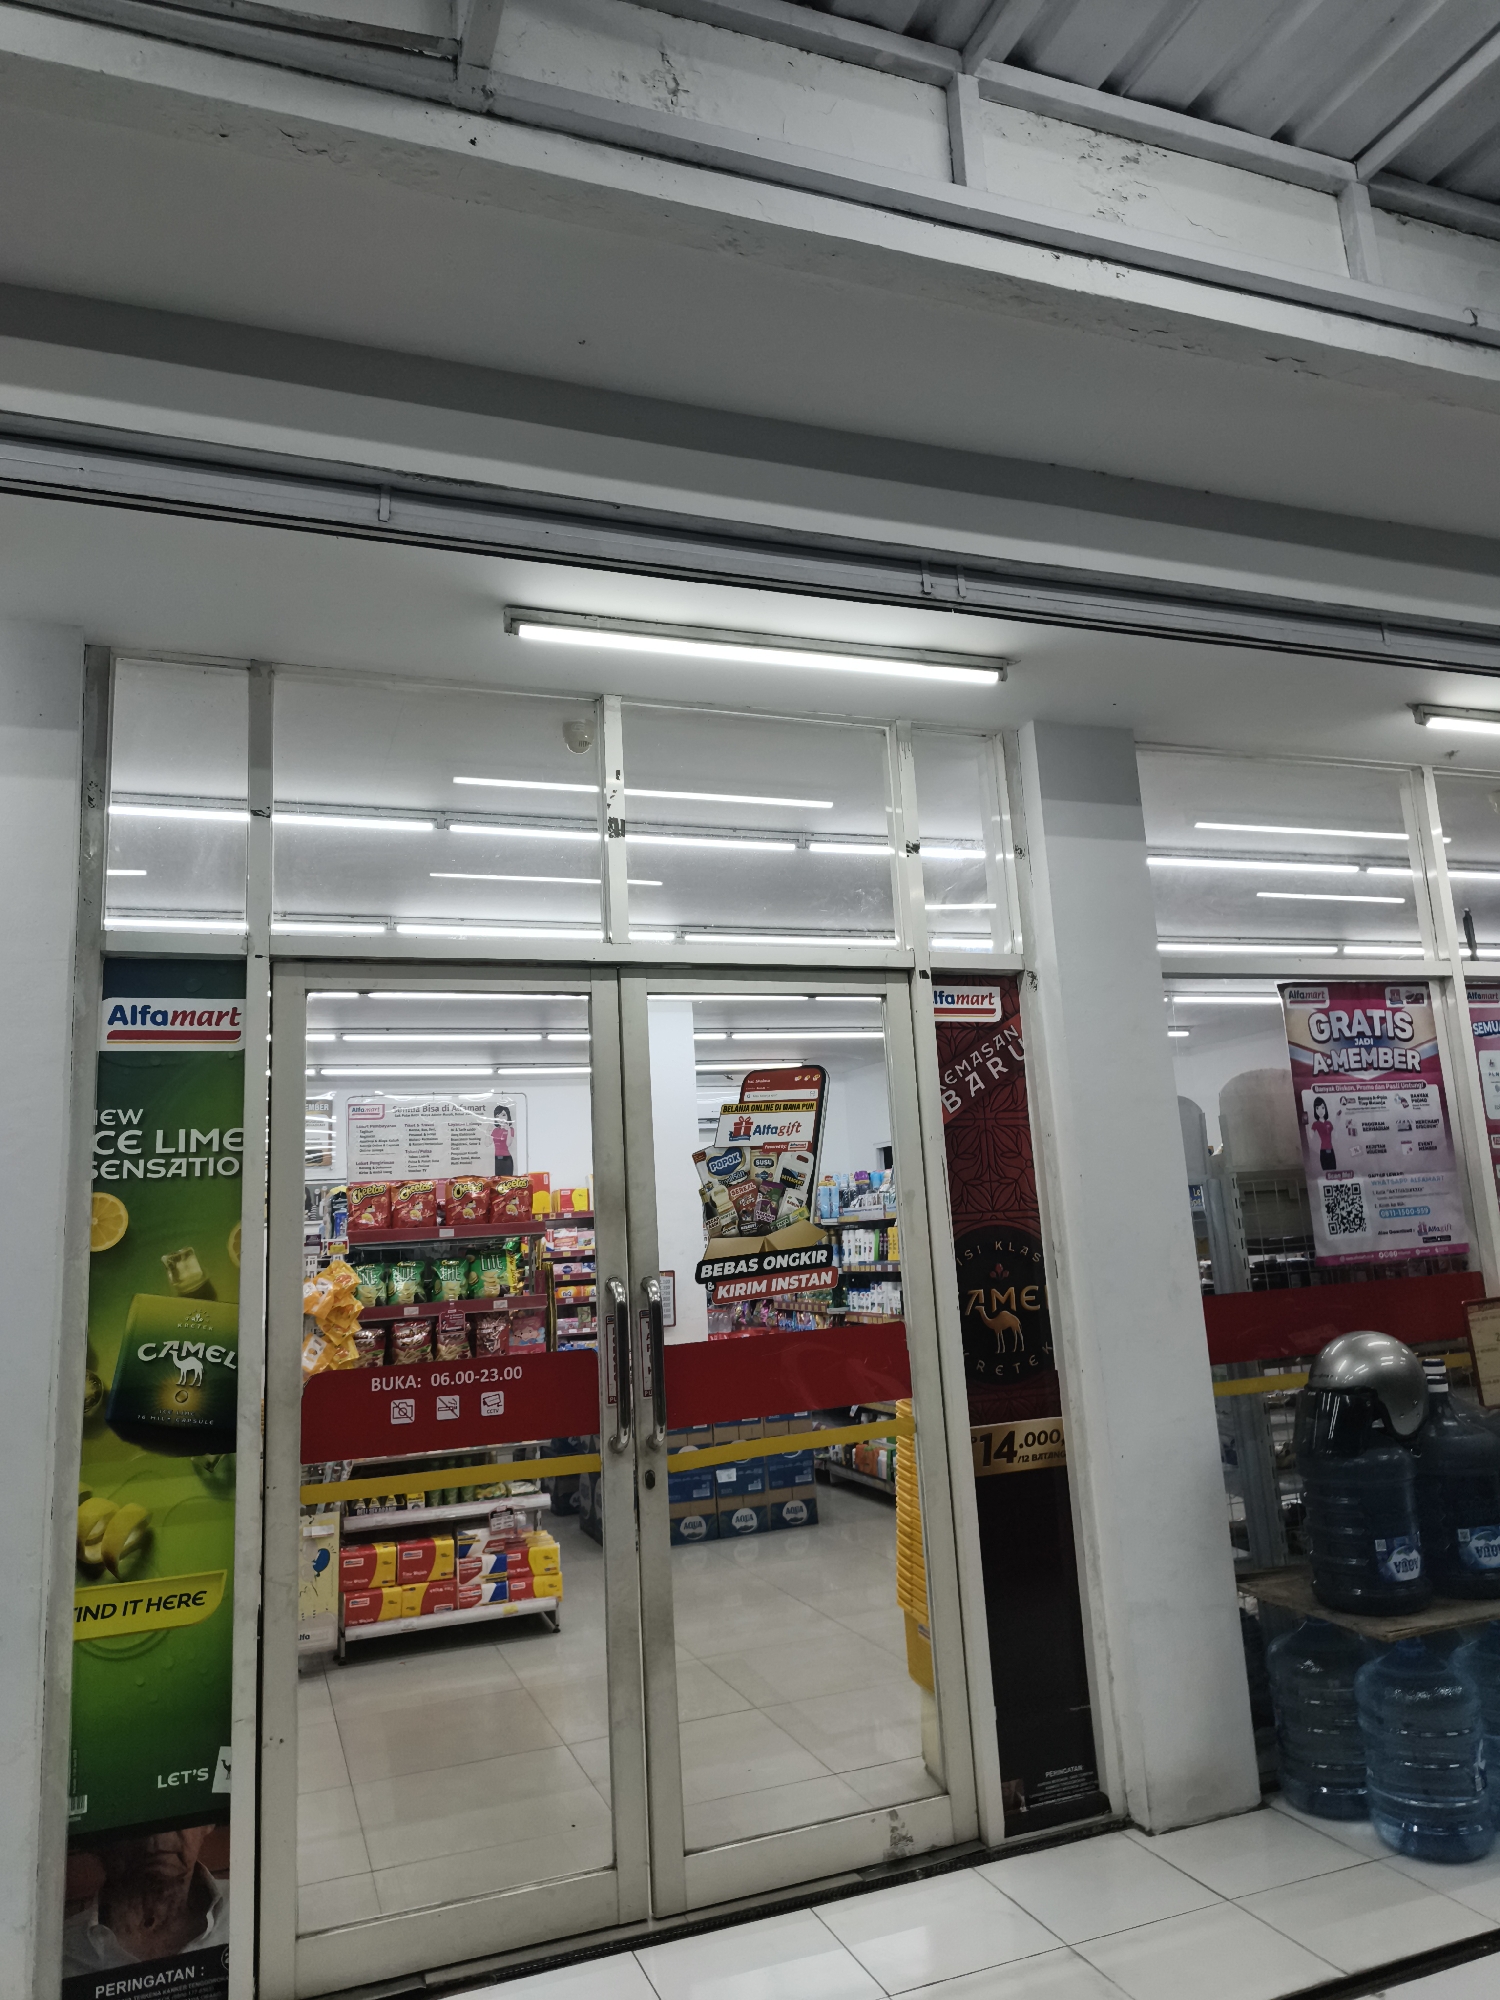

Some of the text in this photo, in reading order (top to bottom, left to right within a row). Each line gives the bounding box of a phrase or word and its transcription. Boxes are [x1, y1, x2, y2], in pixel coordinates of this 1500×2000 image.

[933, 990, 995, 1006] lfamart
[1289, 989, 1326, 1000] Alfamart
[1467, 991, 1499, 1000] Alfamart
[107, 1004, 242, 1026] Alfamart
[1308, 1009, 1414, 1042] GRATIS
[1472, 1020, 1500, 1035] SEMU
[1354, 1038, 1374, 1046] JADI
[941, 1039, 1024, 1114] BARU
[422, 1104, 439, 1113] Bisa
[441, 1104, 450, 1112] di
[723, 1104, 750, 1112] BELANJA
[751, 1103, 774, 1112] ONLINE
[801, 1102, 815, 1110] PUN
[752, 1121, 802, 1136] Alfagift
[155, 1128, 244, 1154] LIME
[709, 1152, 742, 1172] POPOK
[352, 1184, 386, 1205] Cheetos
[730, 1182, 757, 1197] SEREAL
[480, 1254, 503, 1272] LITE
[700, 1250, 828, 1279] BEBAS ONGKIR
[707, 1271, 833, 1299] & KIRIM INSTAN
[137, 1340, 237, 1370] CAMEL
[371, 1366, 523, 1392] BUKA: 06.00-23.00
[735, 1513, 754, 1523] AQUA
[785, 1505, 804, 1515] AQUA
[684, 1520, 703, 1530] AQUA
[122, 1599, 144, 1616] IT
[145, 1590, 207, 1613] HERE
[157, 1767, 209, 1788] LET'S
[1044, 1765, 1083, 1778] PERINGATAN
[95, 1966, 195, 1999] PERINGATAN
